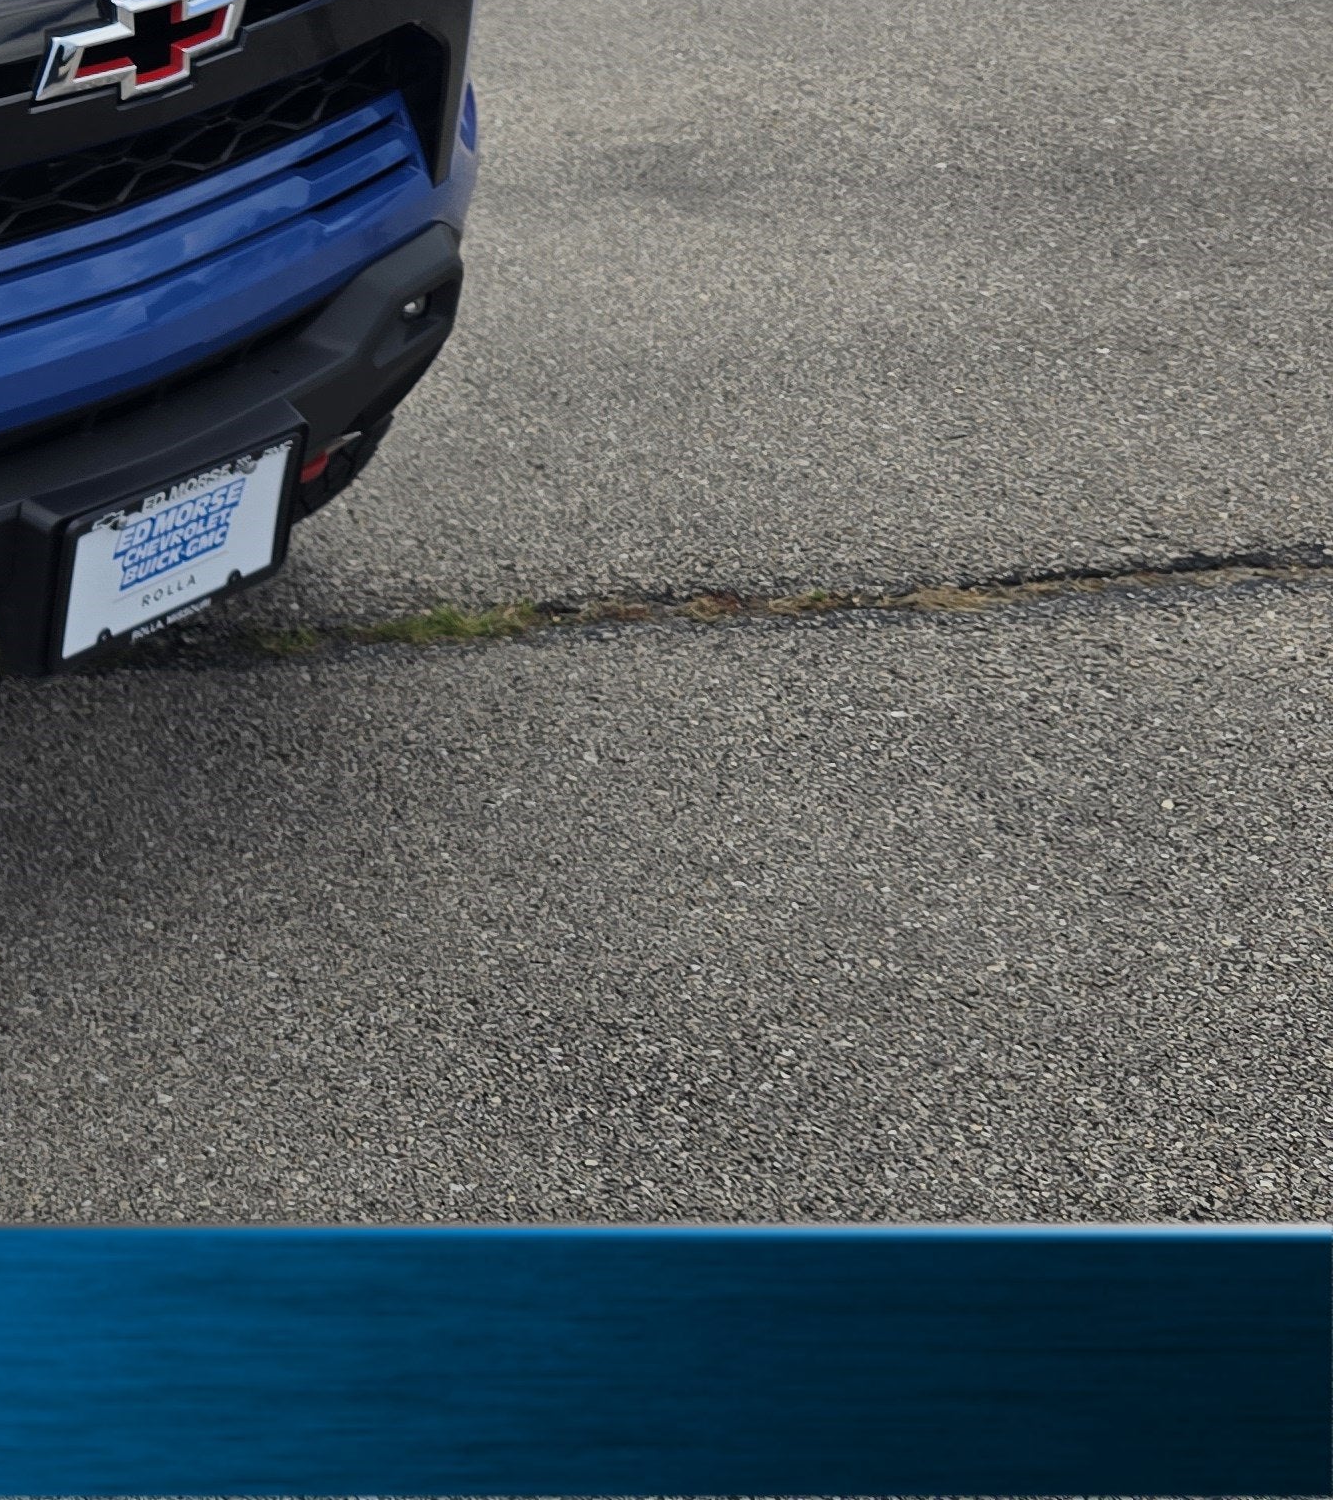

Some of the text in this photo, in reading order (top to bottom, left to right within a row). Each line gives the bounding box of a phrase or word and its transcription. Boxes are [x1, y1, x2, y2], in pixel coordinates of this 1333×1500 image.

[116, 481, 245, 555] ED MORSE
[122, 508, 231, 567] CHEVROLET
[121, 524, 230, 587] BUICK GMC
[141, 573, 196, 607] ROLLA
